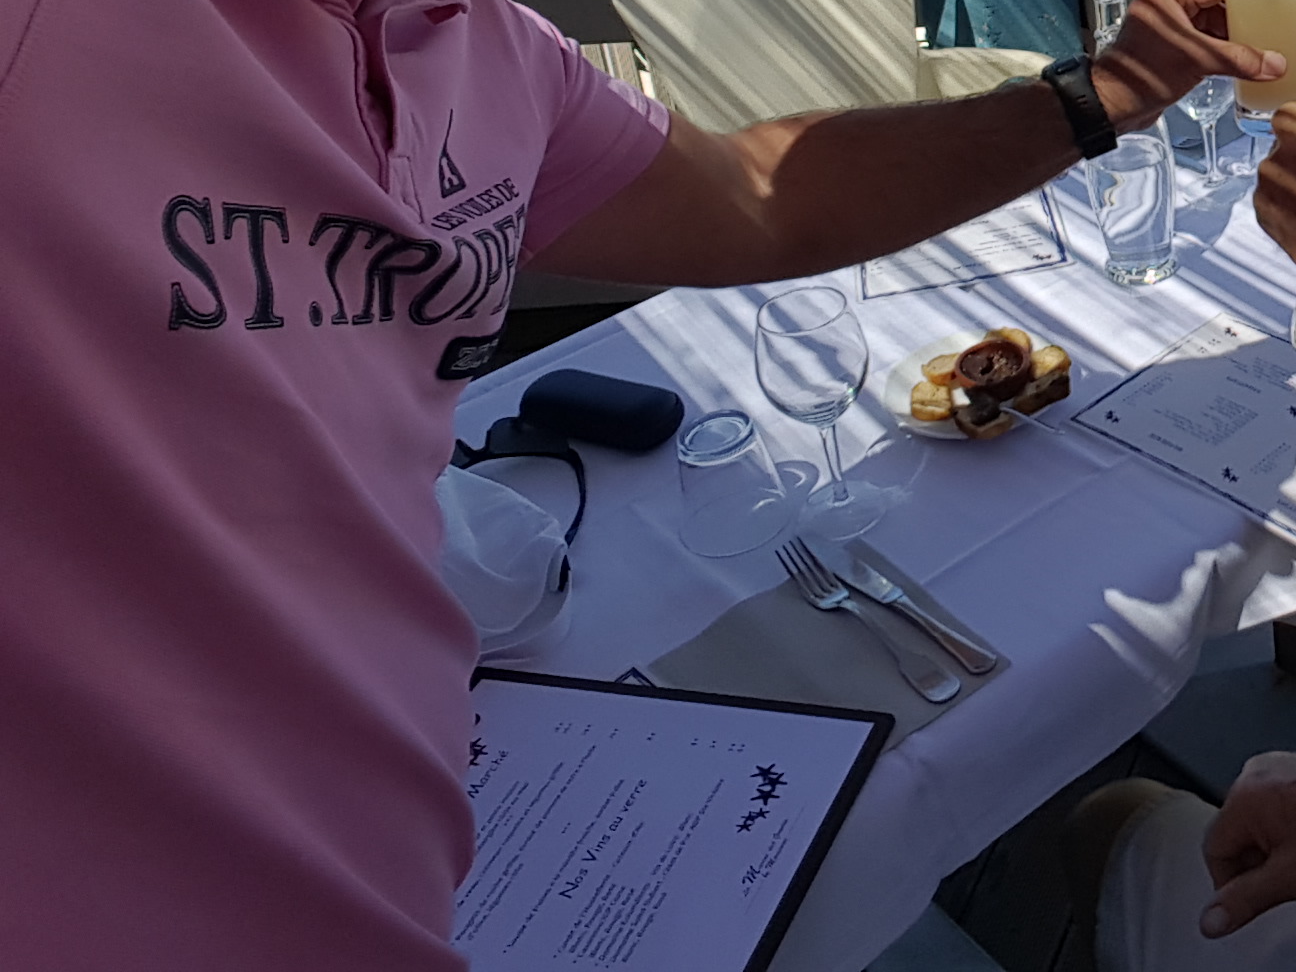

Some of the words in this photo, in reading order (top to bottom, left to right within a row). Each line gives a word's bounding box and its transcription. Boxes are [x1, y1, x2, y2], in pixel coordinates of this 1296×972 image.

[448, 188, 505, 219] VOILES
[493, 177, 520, 203] DE
[431, 211, 468, 231] LES
[557, 868, 589, 900] Nos
[580, 833, 611, 862] Vins
[608, 815, 625, 834] au
[620, 779, 648, 813] verre
